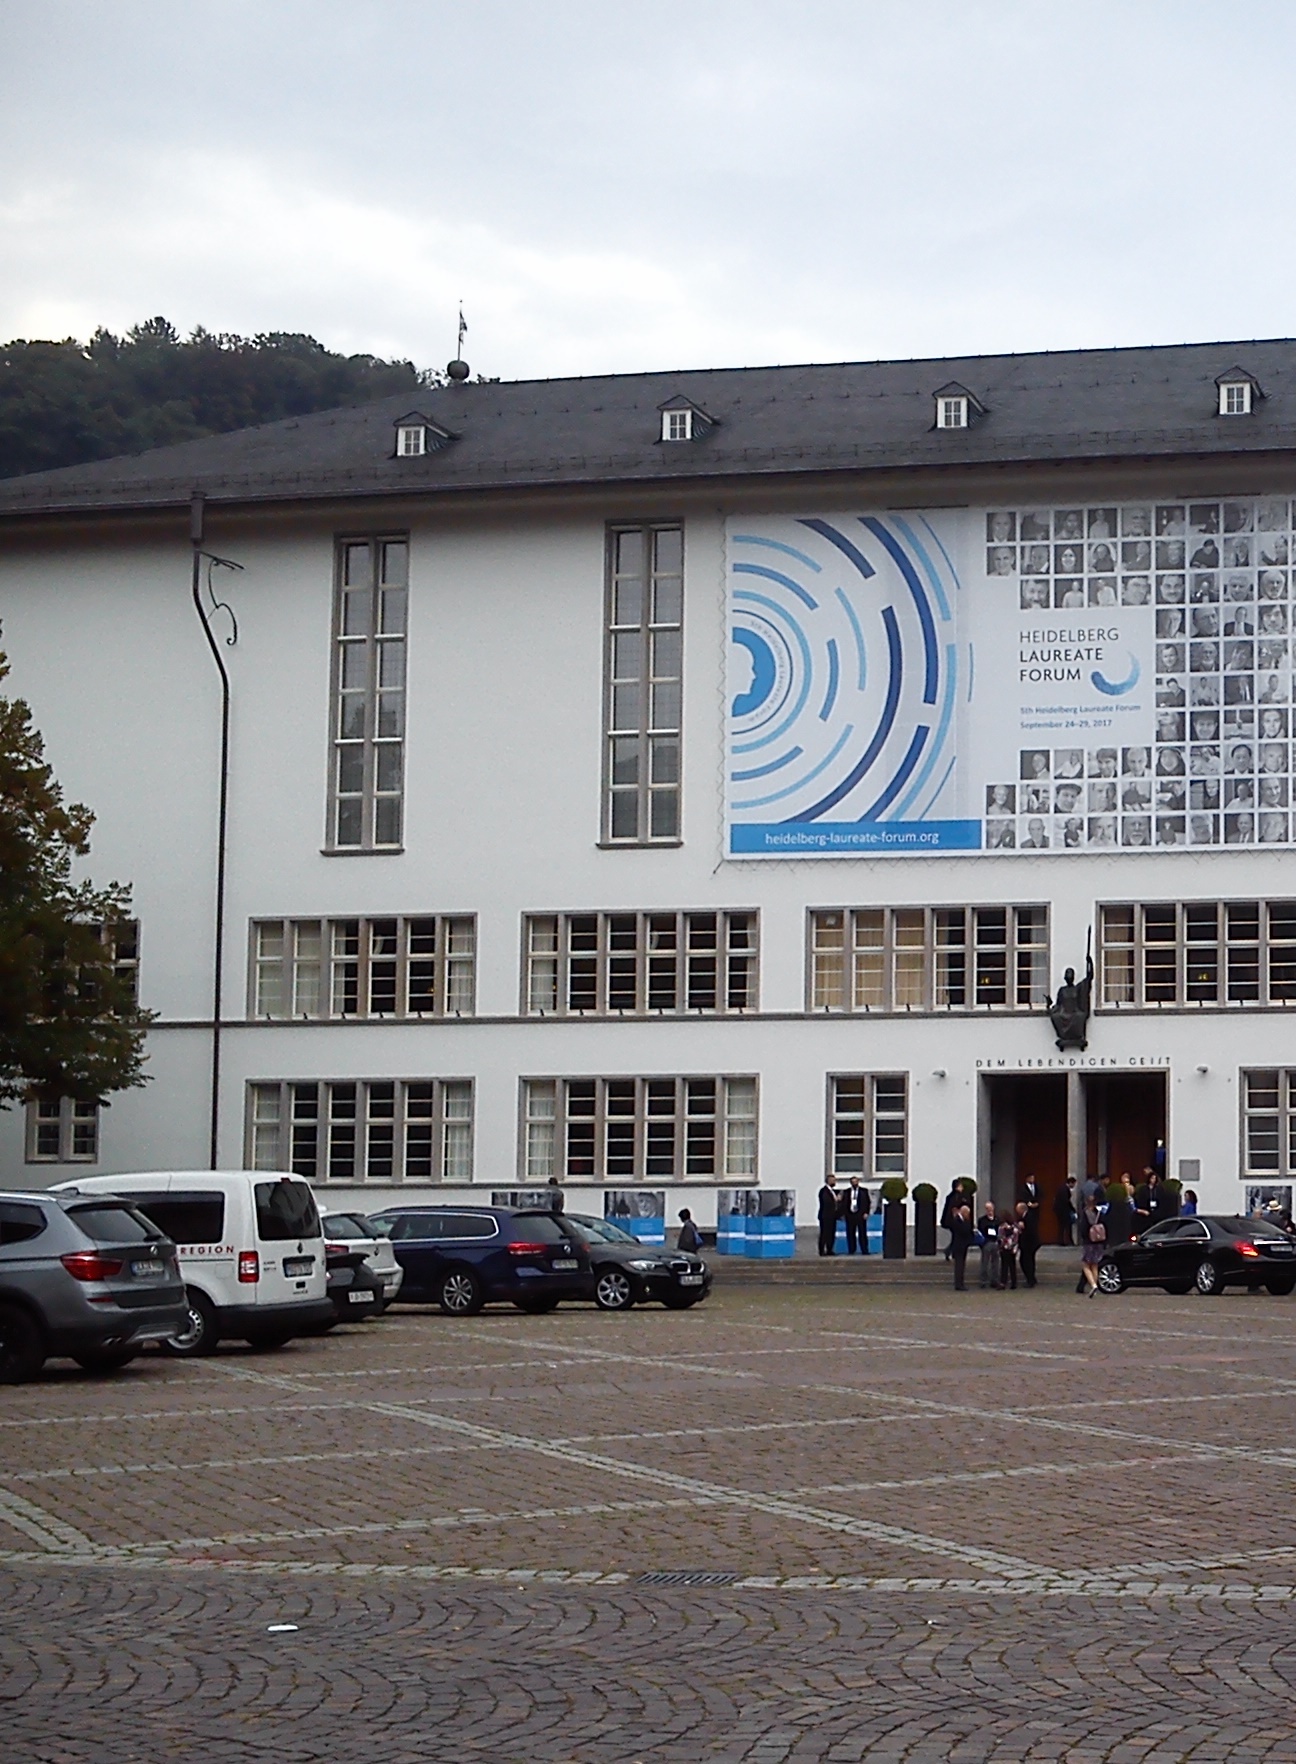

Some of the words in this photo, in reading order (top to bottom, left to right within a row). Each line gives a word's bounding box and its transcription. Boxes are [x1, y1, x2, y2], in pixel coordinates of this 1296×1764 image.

[1020, 627, 1119, 643] HEIDELBERG
[1020, 648, 1103, 663] LAUREATE
[1020, 668, 1080, 682] FORUM
[1020, 707, 1034, 715] 5th
[1035, 705, 1078, 715] Heidelberg
[1080, 704, 1114, 713] Laureate
[1115, 704, 1141, 712] Forum
[1020, 721, 1063, 730] September
[1093, 719, 1113, 728] 2017
[764, 831, 940, 846] heidelberg-laureate-forum.org
[975, 1059, 1005, 1068] DEM
[1018, 1058, 1117, 1067] LEBENDIGEN
[1129, 1056, 1171, 1066] GEIST
[180, 1245, 235, 1256] REGION
